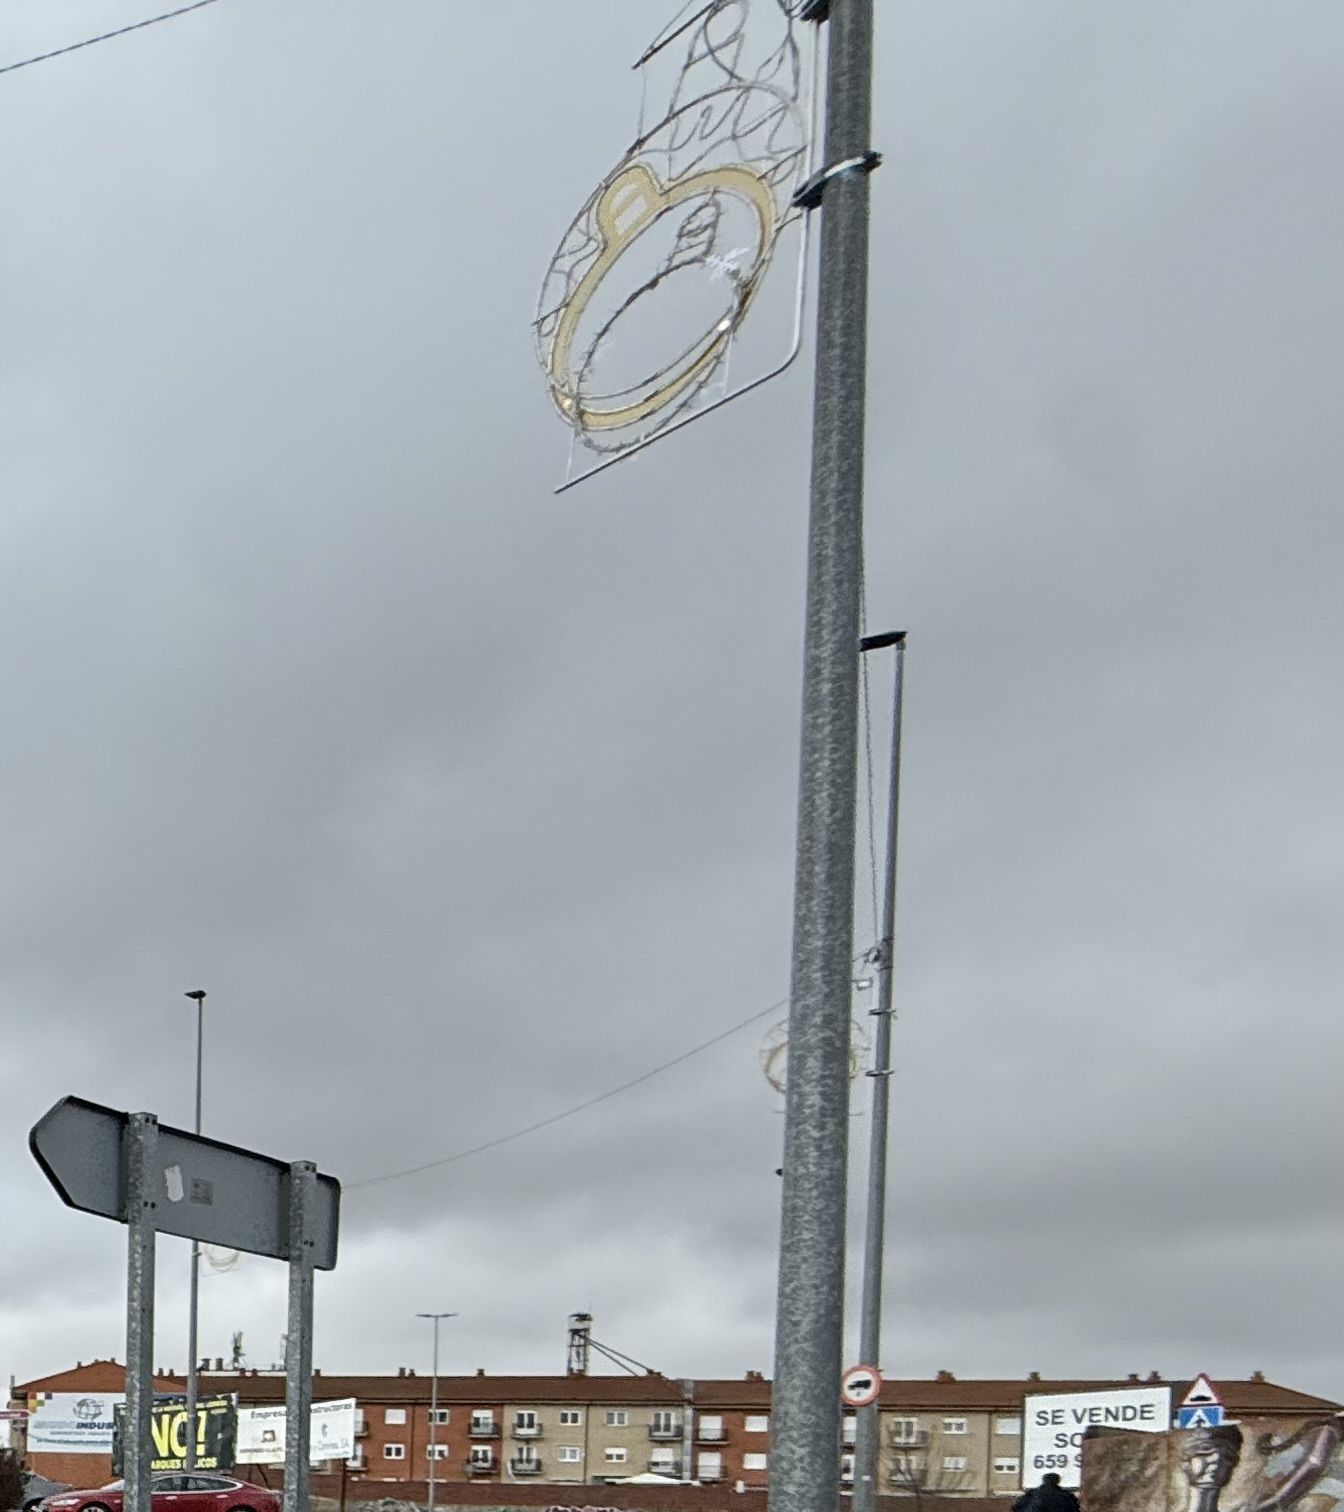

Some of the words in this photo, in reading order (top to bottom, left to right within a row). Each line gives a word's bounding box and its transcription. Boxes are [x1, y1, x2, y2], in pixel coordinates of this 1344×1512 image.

[1035, 1409, 1065, 1426] SE
[1072, 1403, 1156, 1425] VENDE
[1033, 1454, 1068, 1470] 659
